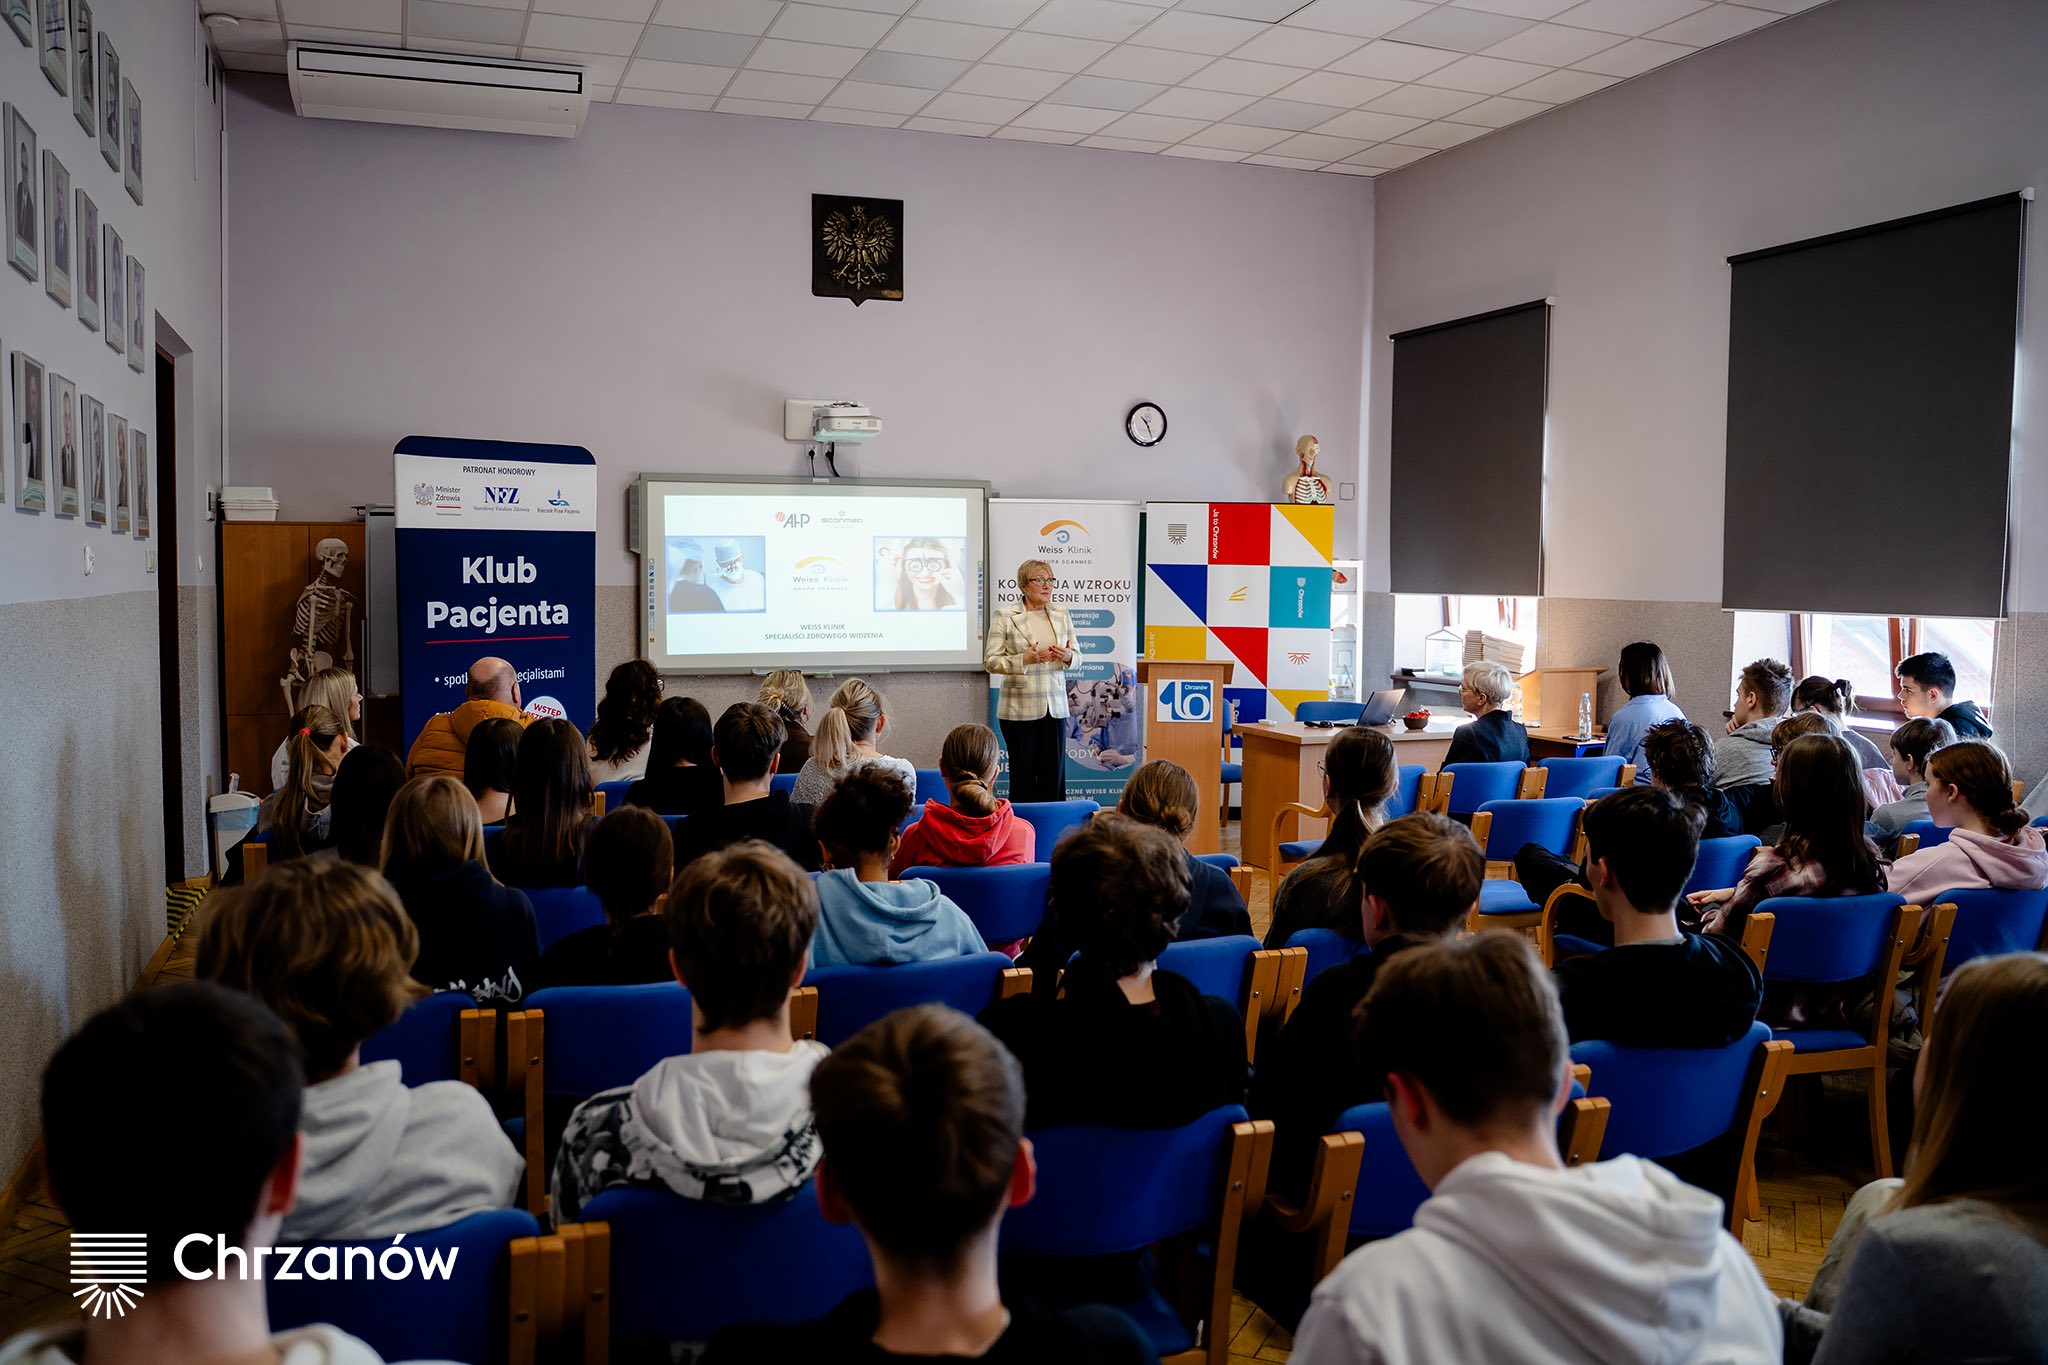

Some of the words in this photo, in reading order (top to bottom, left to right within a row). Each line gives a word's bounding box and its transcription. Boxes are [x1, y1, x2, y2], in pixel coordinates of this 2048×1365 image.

[462, 465, 496, 474] PATRONAT
[498, 467, 536, 476] HONOROWY
[435, 486, 461, 494] Minister
[435, 494, 461, 502] Zdrowia
[484, 486, 520, 504] NFZ
[1213, 509, 1219, 518] Ja
[1038, 546, 1064, 554] Weiss
[1068, 546, 1092, 554] Klinik
[462, 555, 538, 584] Klub
[1073, 580, 1131, 590] WZROKU
[1084, 594, 1132, 603] METODY
[427, 596, 570, 634] Pacjenta
